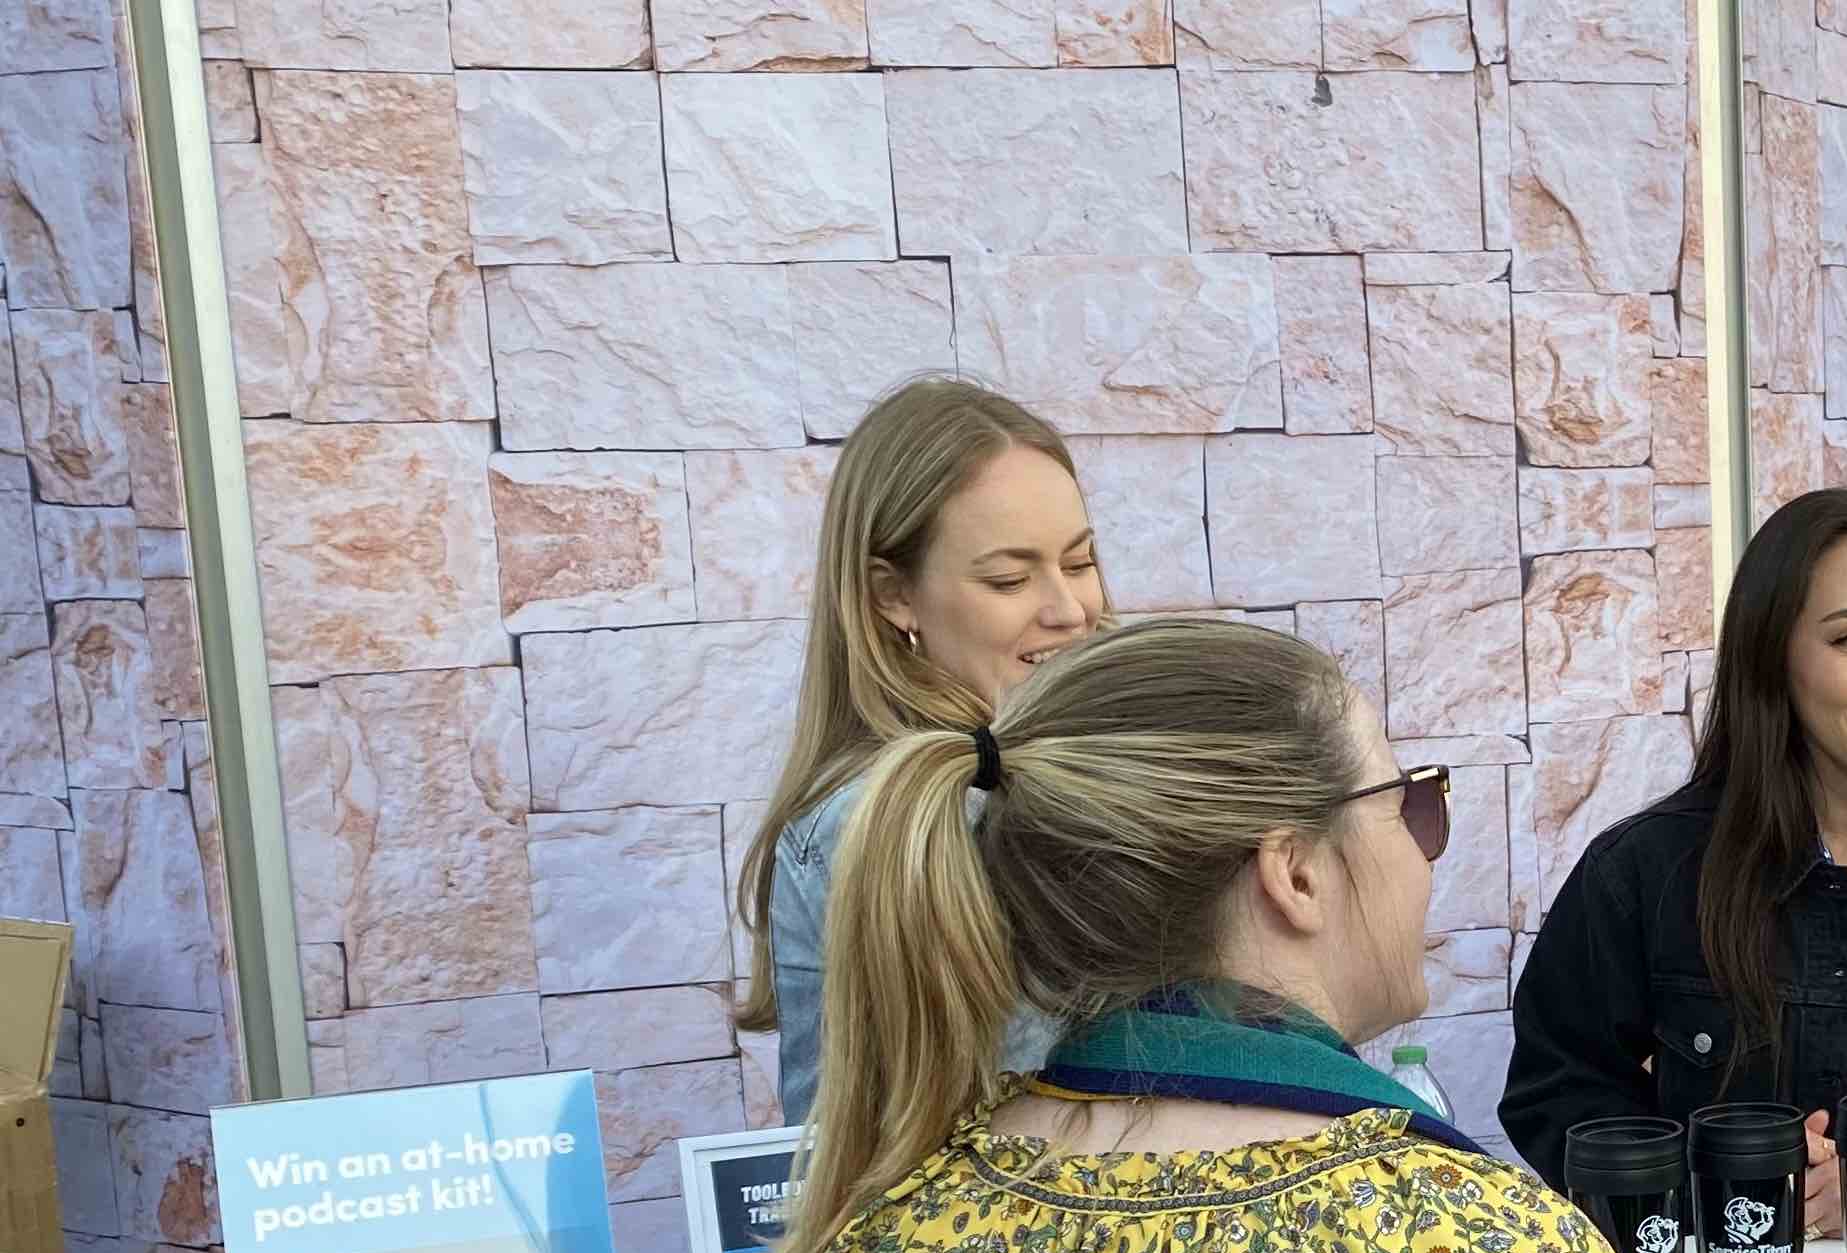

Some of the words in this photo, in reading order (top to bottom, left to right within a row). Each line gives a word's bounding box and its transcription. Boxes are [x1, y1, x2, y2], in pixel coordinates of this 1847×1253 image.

[247, 1152, 328, 1189] Win
[338, 1151, 392, 1179] an
[401, 1131, 576, 1171] at-home
[254, 1184, 422, 1242] podcast
[431, 1173, 495, 1211] kit!
